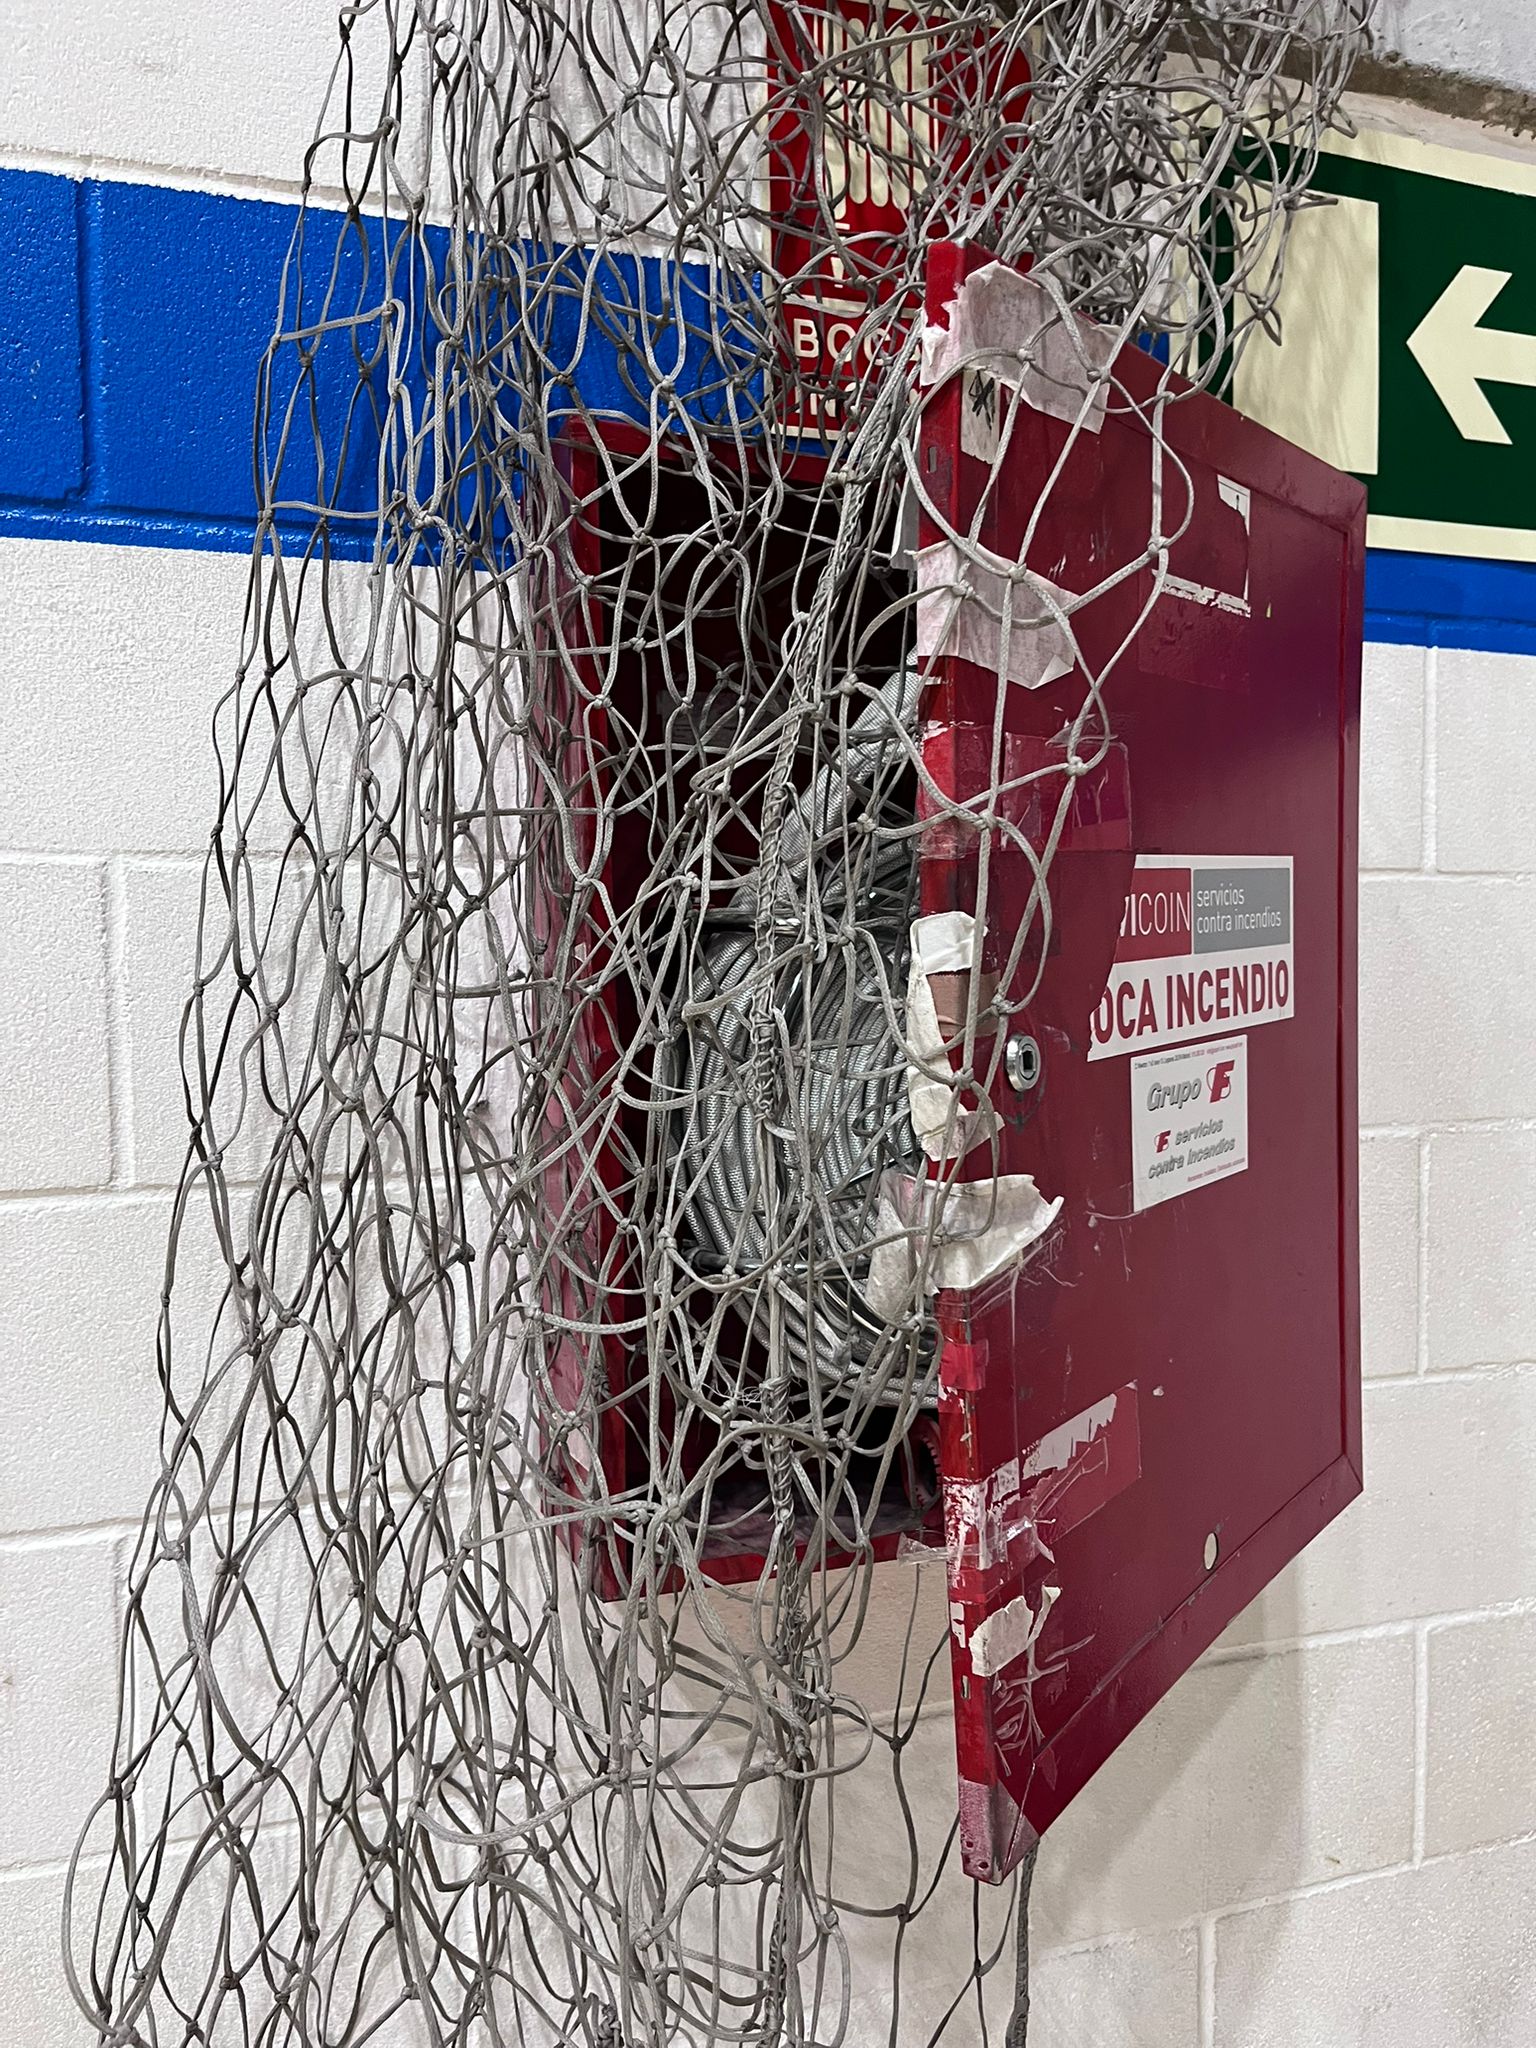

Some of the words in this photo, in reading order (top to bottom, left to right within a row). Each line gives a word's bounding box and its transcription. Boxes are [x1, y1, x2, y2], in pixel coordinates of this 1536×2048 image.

[793, 318, 921, 366] BOC
[1196, 882, 1245, 908] servicios
[1196, 911, 1233, 934] contra
[1234, 906, 1282, 931] incendios
[1166, 959, 1289, 1030] INCENDIO
[1146, 1077, 1202, 1111] Grupo
[1175, 1118, 1224, 1146] servicios
[1148, 1155, 1185, 1179] contra
[1186, 1137, 1236, 1166] incendios
